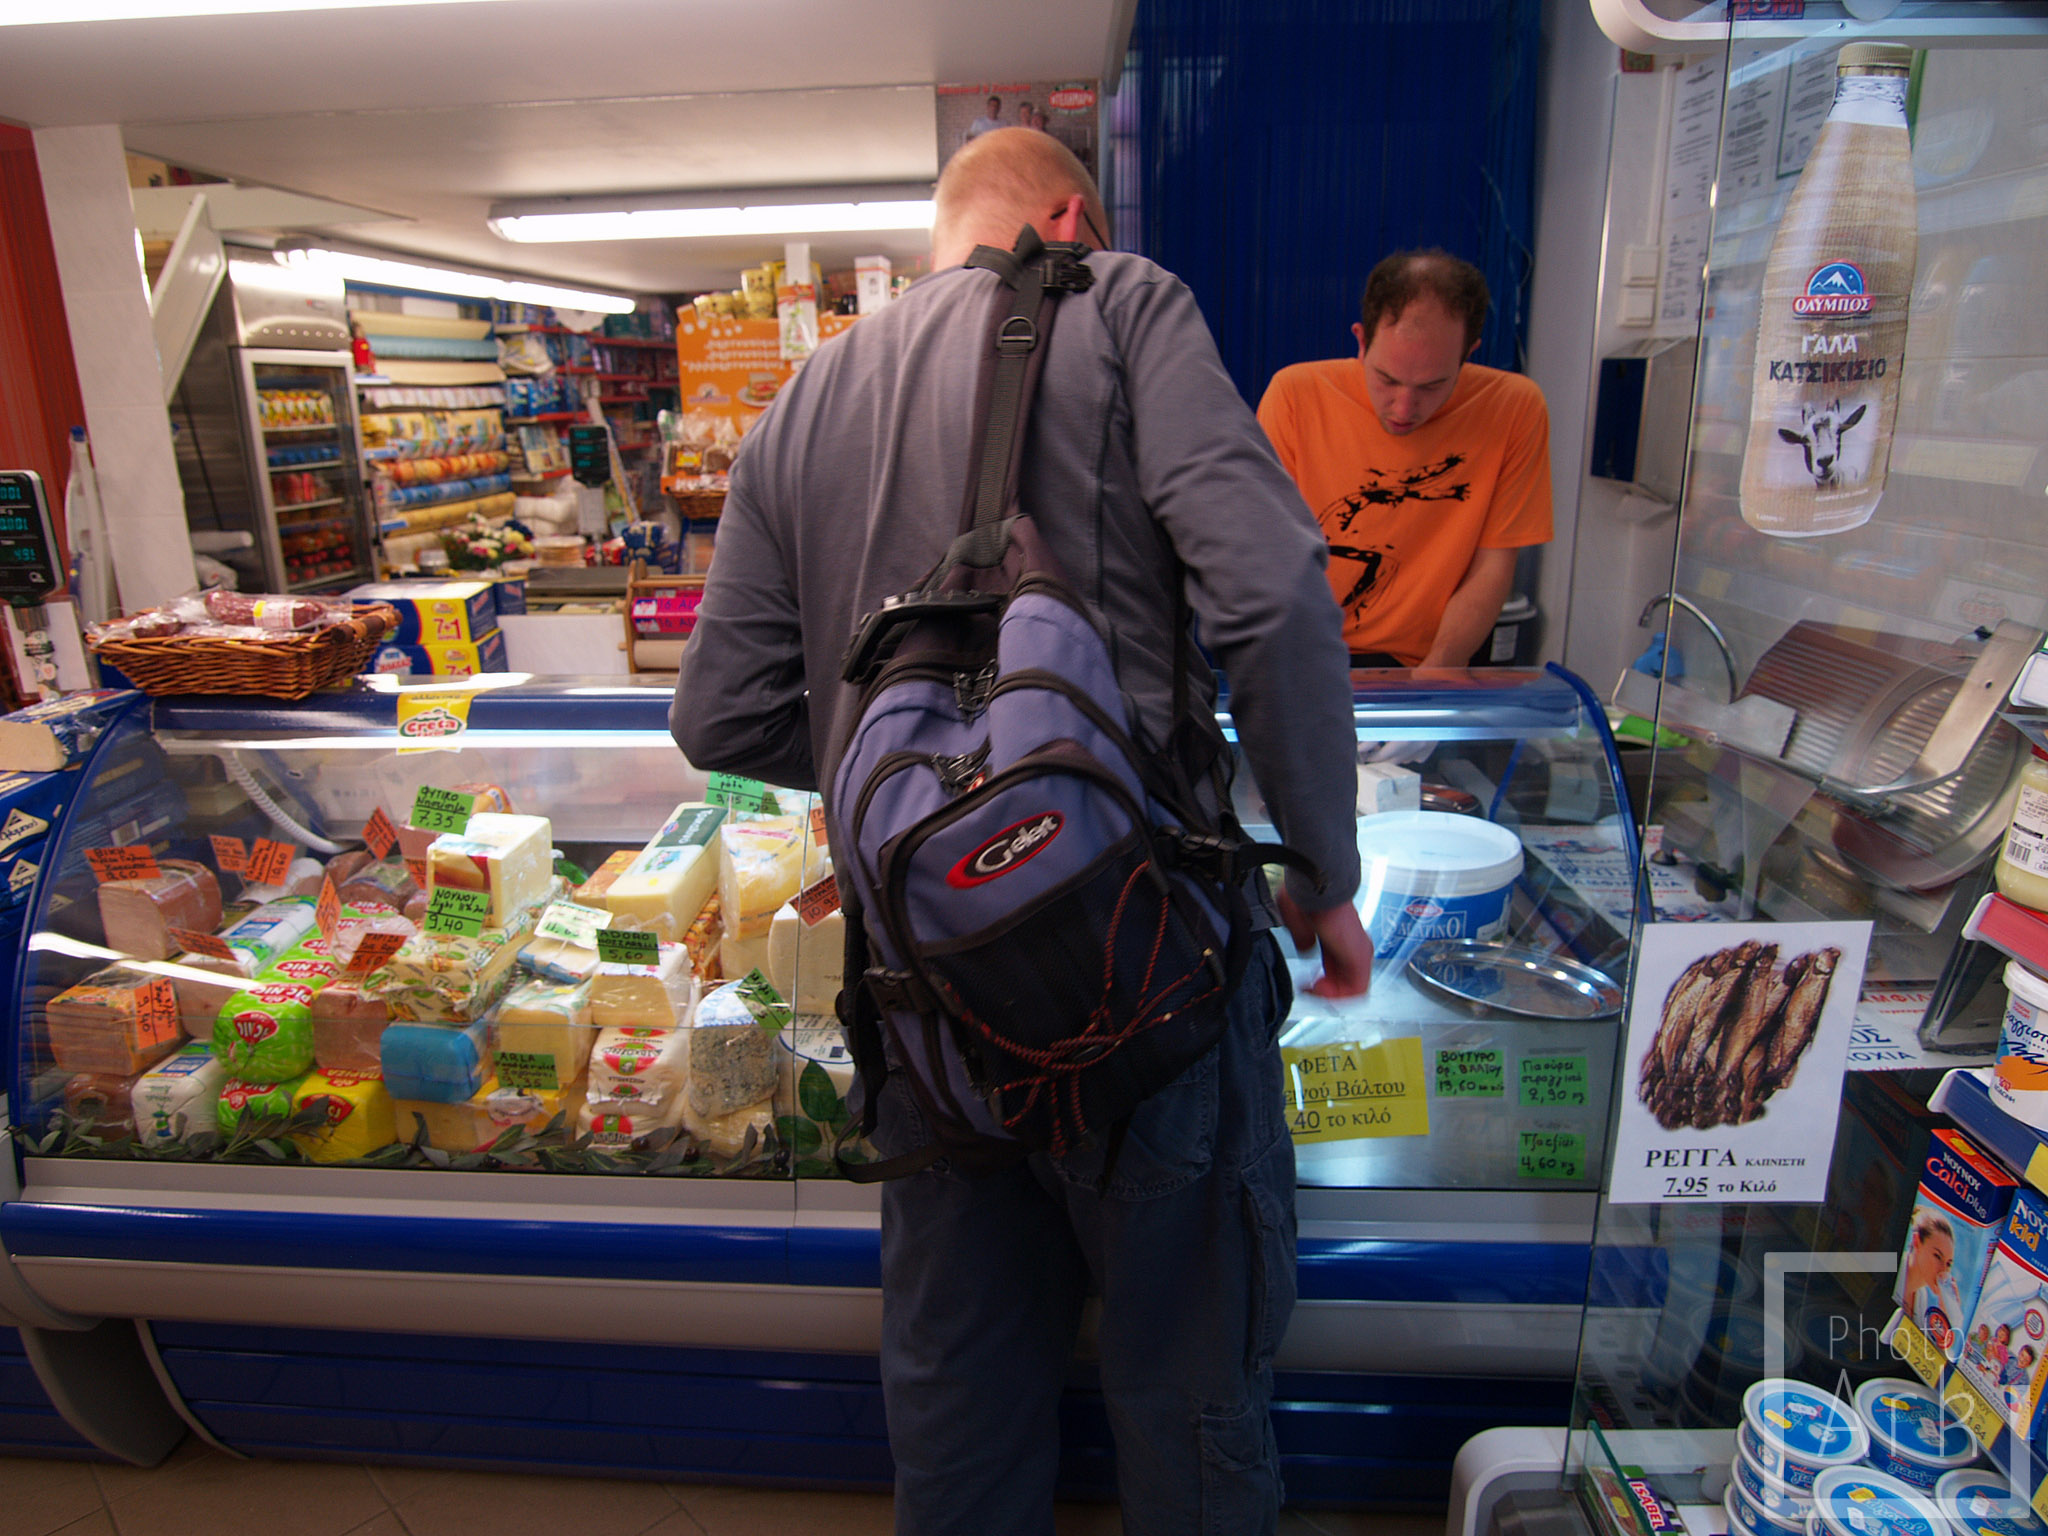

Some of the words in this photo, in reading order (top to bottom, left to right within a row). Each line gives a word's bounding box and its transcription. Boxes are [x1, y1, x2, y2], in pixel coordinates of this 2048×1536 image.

[1795, 298, 1871, 311] ΟΛΥΜΠΟΣ
[1801, 333, 1858, 354] ΓΑΛΑ
[1769, 358, 1887, 383] ΚΑΤΣΙΚΙΣΙΟ
[406, 720, 456, 734] Creta
[418, 810, 454, 828] 7,35
[974, 815, 1058, 873] Gelert
[608, 950, 644, 960] 5,60
[1299, 1055, 1357, 1075] ΦΕΤΑ
[1337, 1079, 1405, 1098] Βάλτου
[1326, 1117, 1347, 1128] το
[1352, 1108, 1392, 1126] κιλό
[1520, 1156, 1556, 1172] 4,60
[1645, 1149, 1737, 1168] ΡΕΓΓΑ
[1745, 1157, 1806, 1167] ΚΑΠΝΙΣΤΗ
[1663, 1177, 1708, 1196] 7,95
[1717, 1183, 1734, 1193] το
[1740, 1179, 1777, 1193] Κιλό
[2009, 1214, 2040, 1252] kid
[1629, 1481, 1664, 1528] ISABEL
